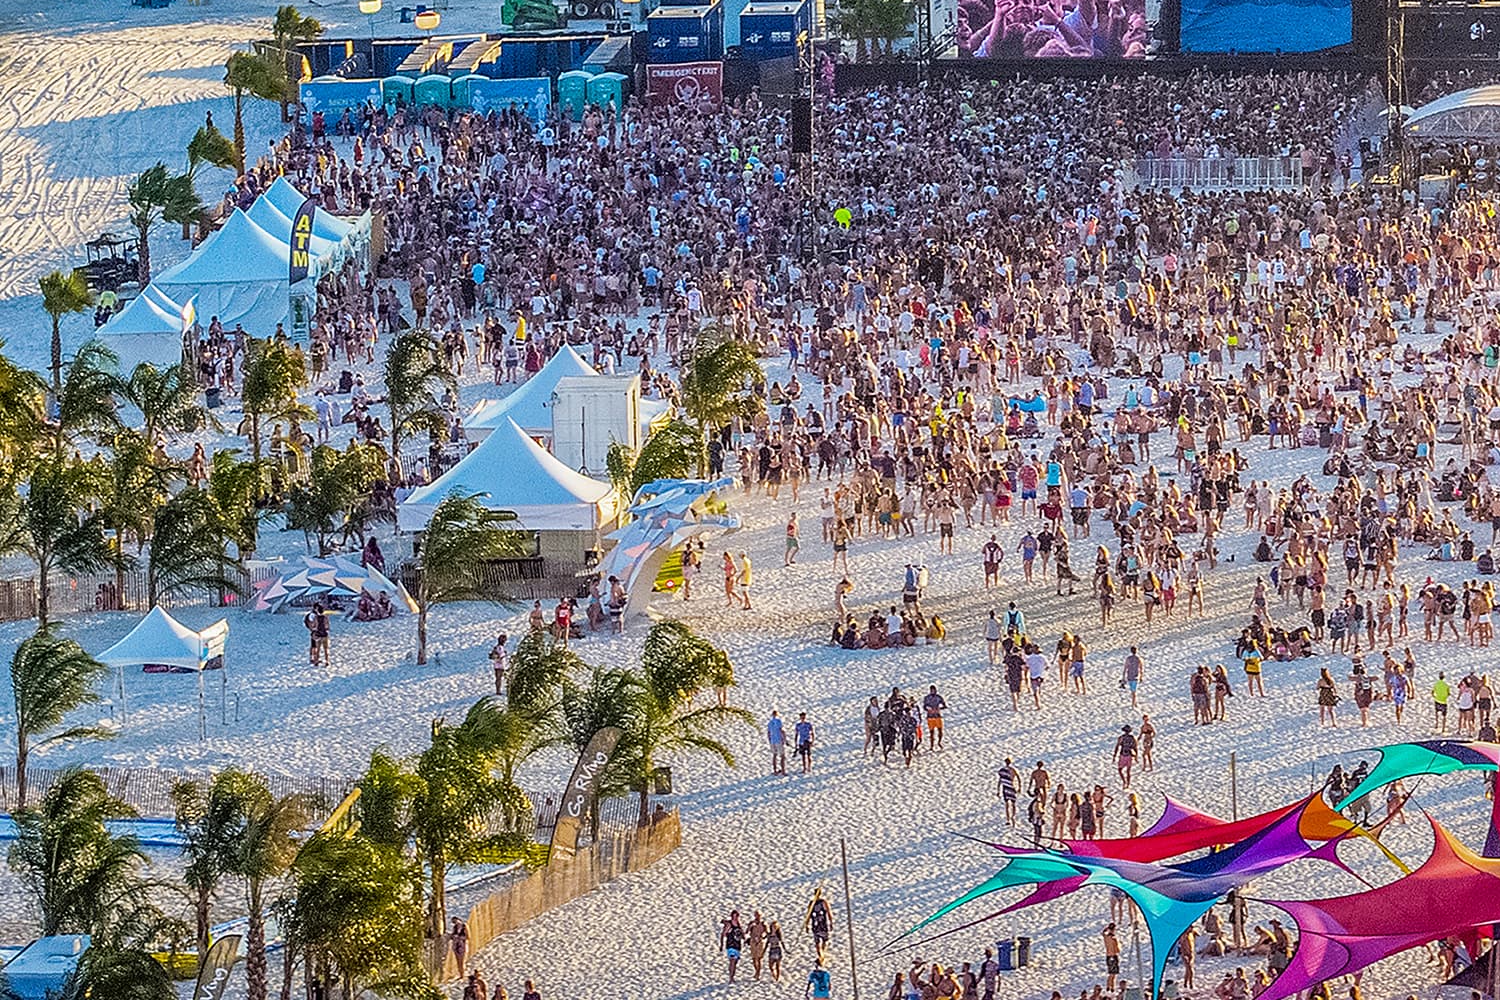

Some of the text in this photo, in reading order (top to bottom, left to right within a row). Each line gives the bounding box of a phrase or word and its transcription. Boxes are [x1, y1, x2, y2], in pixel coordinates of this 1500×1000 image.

[651, 67, 718, 78] EMERGENCY EXIT
[293, 214, 310, 267] ATM
[567, 794, 585, 818] Go
